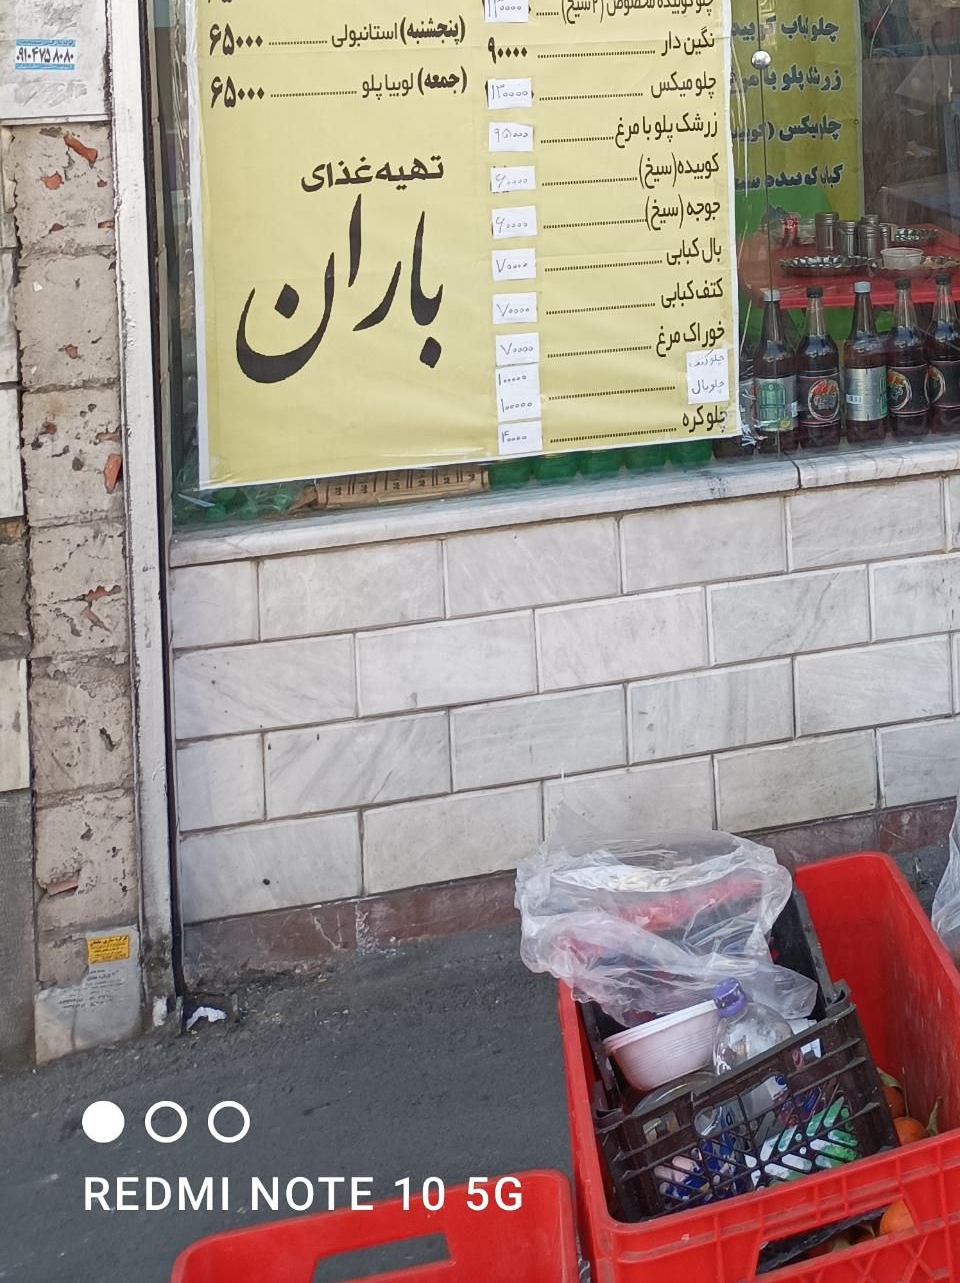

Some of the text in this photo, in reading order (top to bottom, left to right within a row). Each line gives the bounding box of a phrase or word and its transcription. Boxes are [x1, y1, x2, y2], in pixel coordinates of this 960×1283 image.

[208, 14, 466, 57] (پنجشنبه) استانبولی ۶۵۰۰۰
[487, 25, 716, 65] نگین دار ۹۰۰۰۰
[210, 66, 468, 109] (جمعه) لوبیا پلو ۶۵۰۰۰
[650, 70, 717, 100] چلو میکس
[614, 112, 719, 149] زرشک پلو با مرغ
[300, 154, 444, 193] تهیه غذای
[638, 152, 720, 189] کوبیده (سیخ)
[645, 193, 721, 231] جوجه (سیخ)
[665, 236, 723, 266] بال کبابی
[236, 193, 444, 384] باران
[660, 277, 724, 309] کتف کبابی
[655, 319, 726, 358] خوراک مرغ
[682, 404, 705, 433] کره
